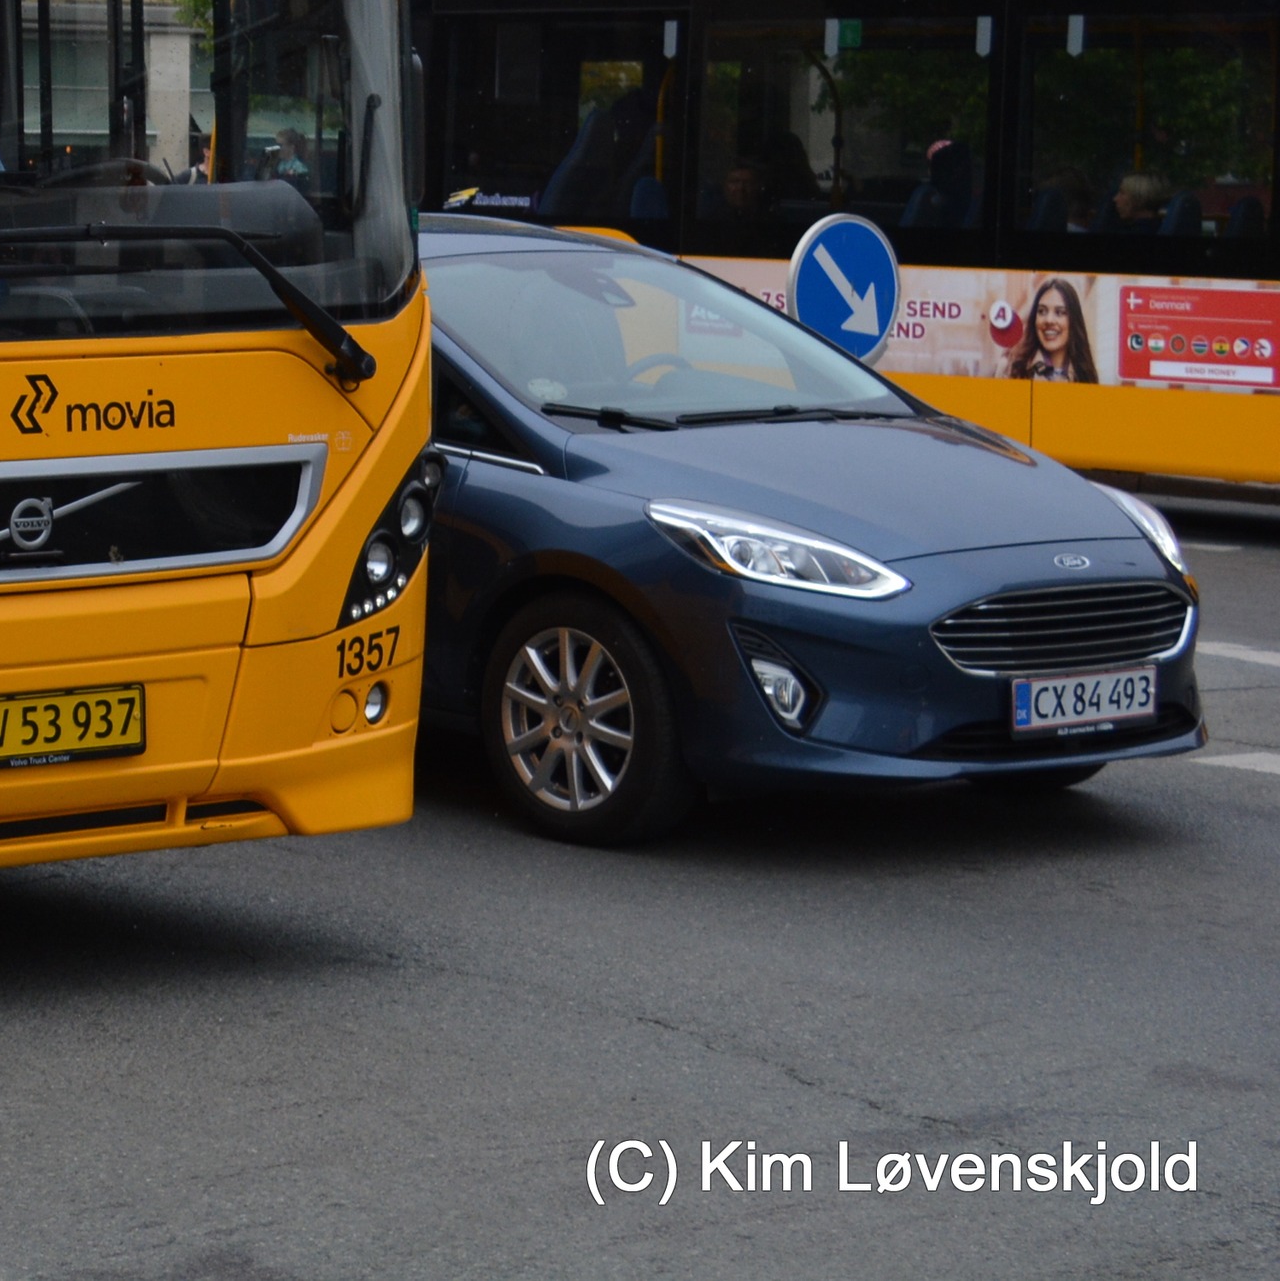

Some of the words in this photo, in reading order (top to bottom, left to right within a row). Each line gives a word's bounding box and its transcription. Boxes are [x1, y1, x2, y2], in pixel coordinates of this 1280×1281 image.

[906, 300, 962, 319] SEND
[1149, 300, 1193, 311] Denmark
[1185, 365, 1206, 375] SEND
[1208, 366, 1237, 377] MONEY
[66, 388, 176, 432] movia
[14, 519, 50, 529] VOLVO
[336, 625, 400, 679] 1357
[1034, 684, 1067, 719] CX
[1072, 680, 1101, 717] 84
[1107, 675, 1151, 711] 493
[20, 703, 62, 746] 53
[71, 696, 137, 742] 937
[10, 757, 28, 767] Volvo
[29, 755, 47, 765] Truck
[48, 753, 71, 764] Center
